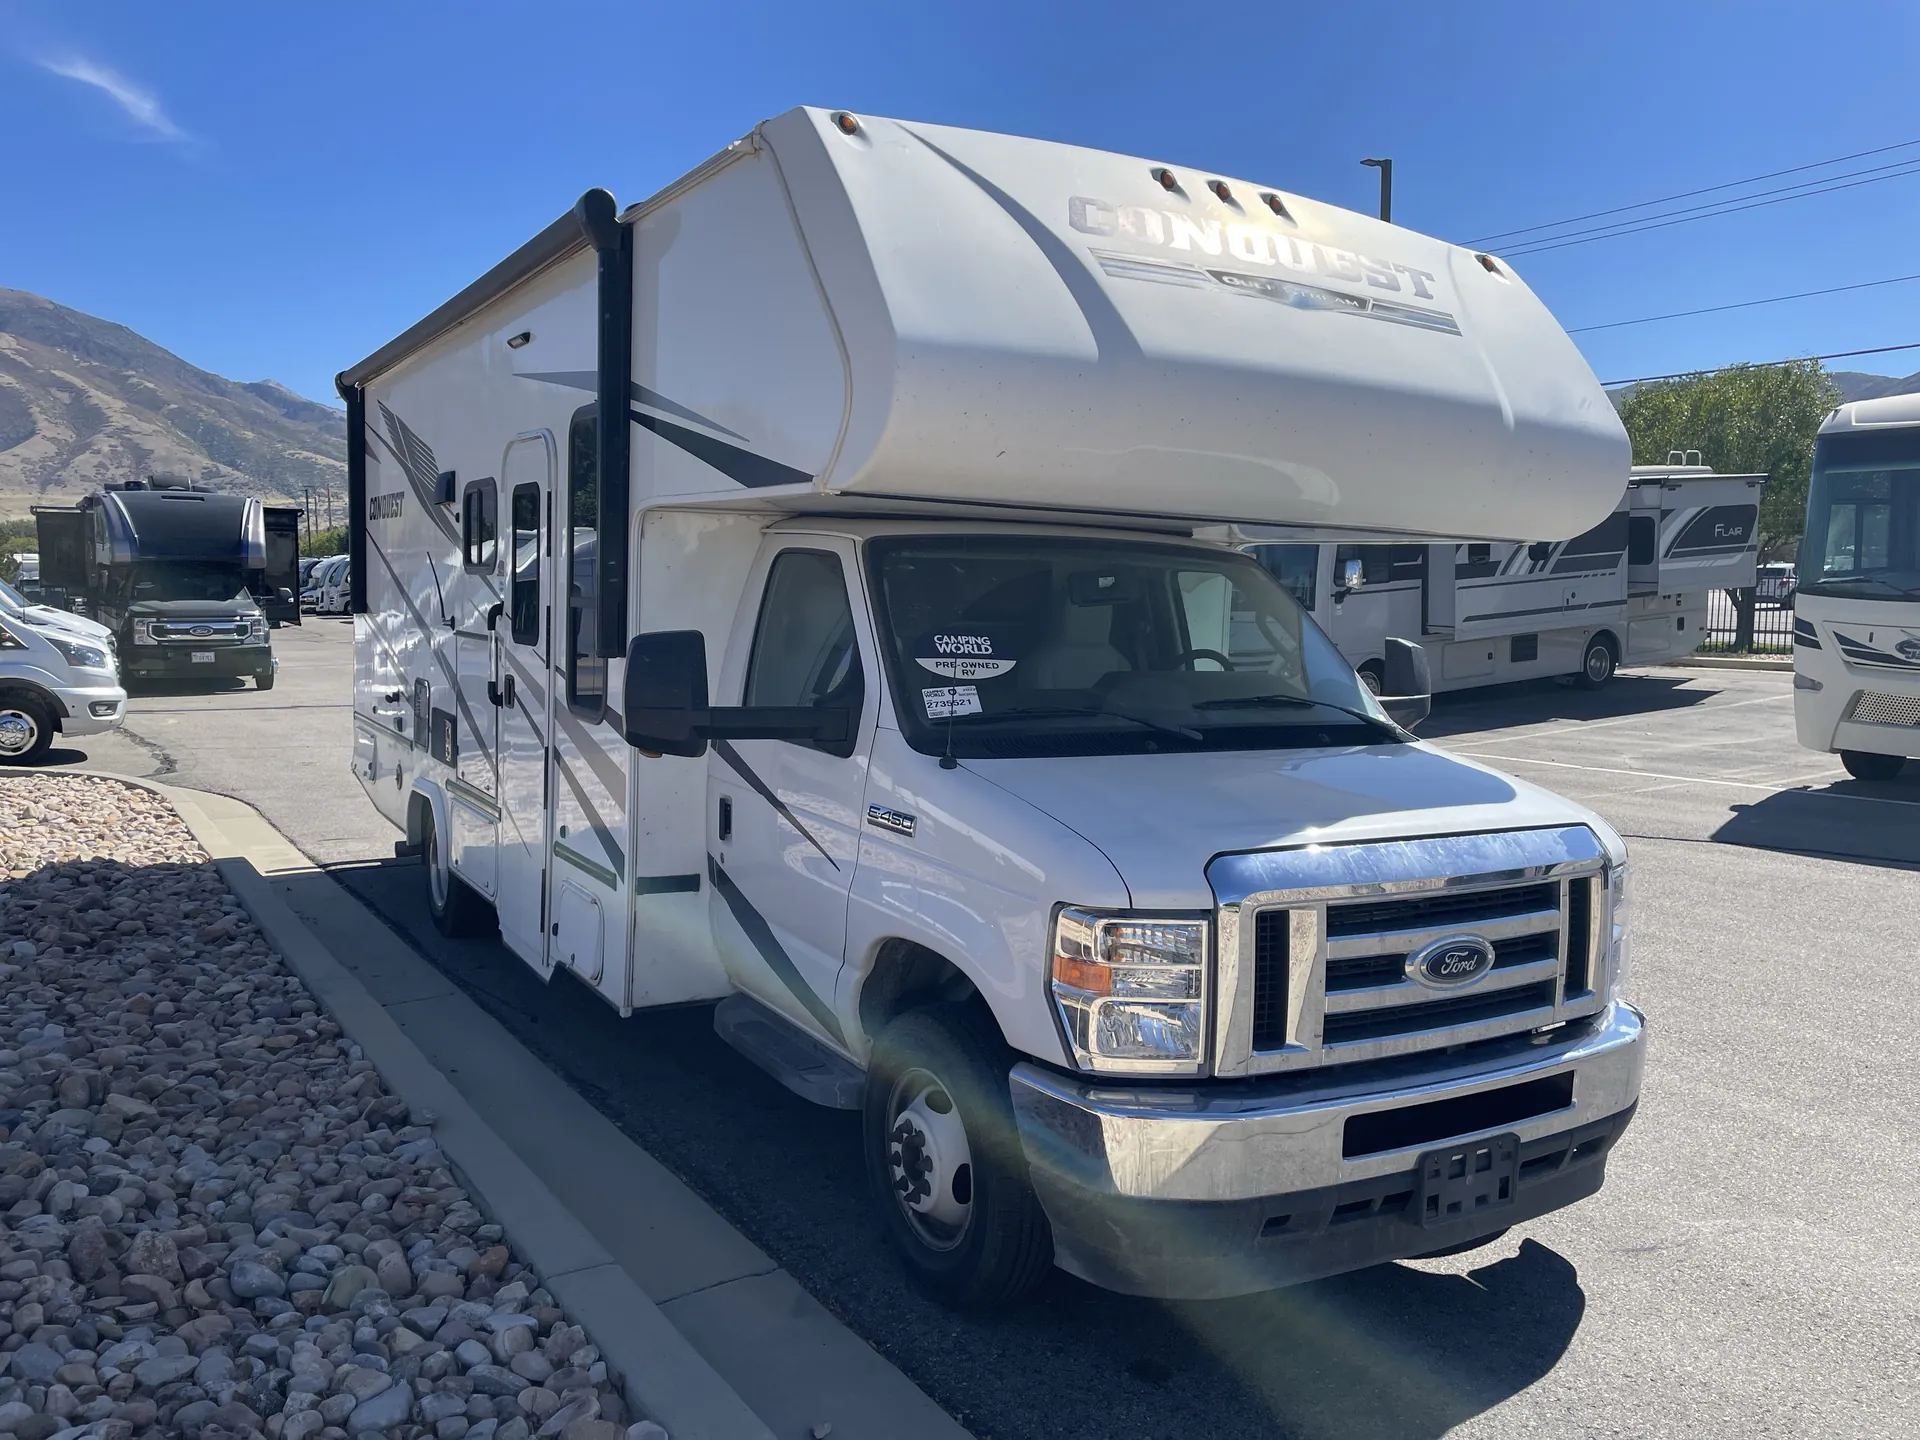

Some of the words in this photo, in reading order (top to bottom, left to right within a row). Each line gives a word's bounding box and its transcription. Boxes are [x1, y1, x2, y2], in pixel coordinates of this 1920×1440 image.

[1068, 195, 1436, 300] CONQUEST
[369, 491, 405, 521] CONQUEST
[933, 634, 991, 645] CAMPING
[935, 643, 994, 655] WORLD
[935, 661, 999, 669] PRE-OWNED
[926, 699, 972, 708] 2735521
[1441, 951, 1478, 975] Ford
